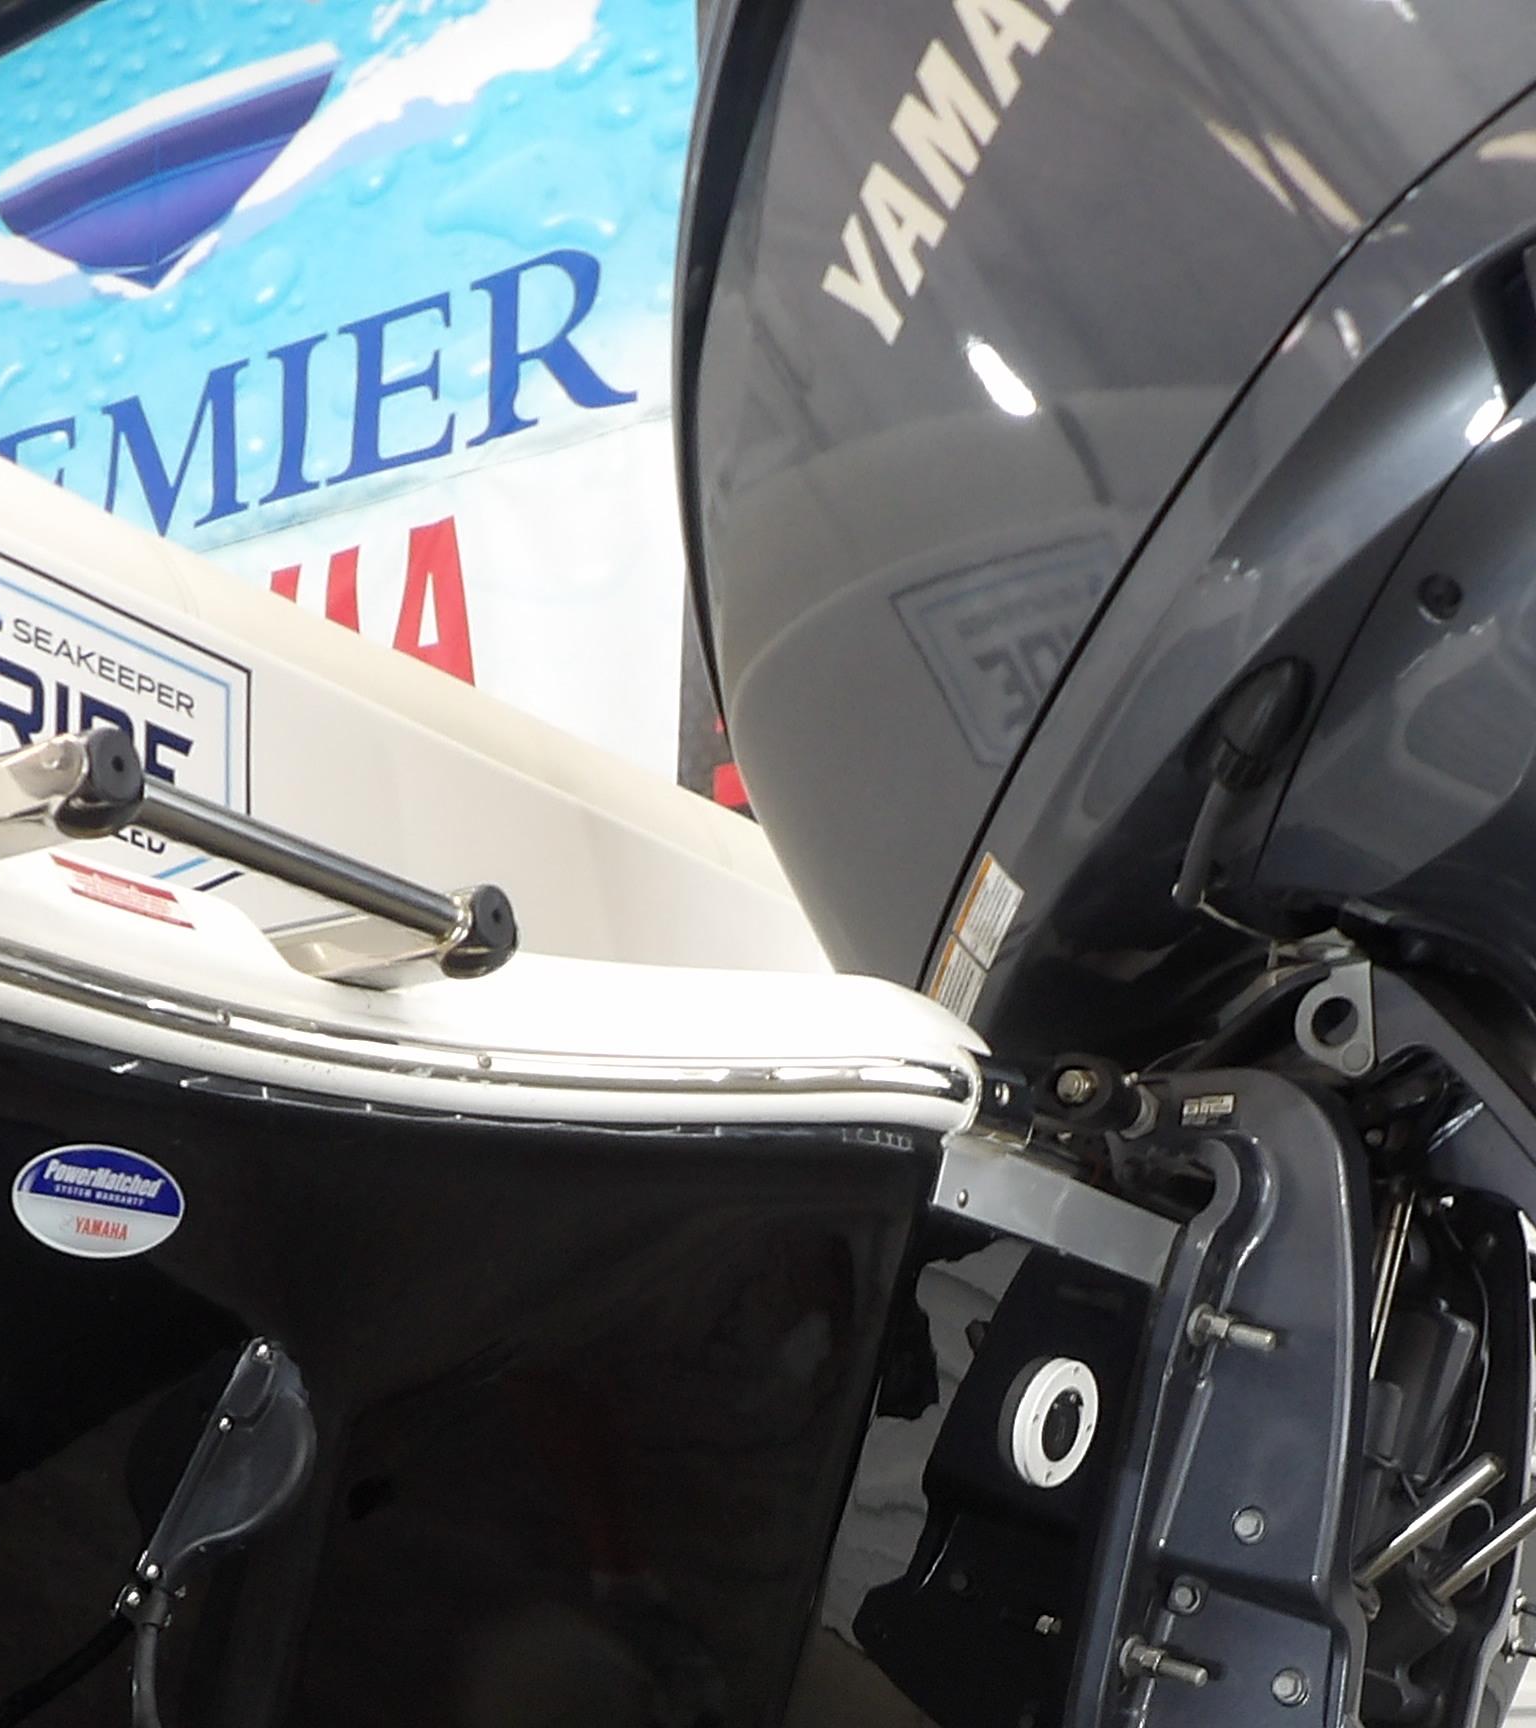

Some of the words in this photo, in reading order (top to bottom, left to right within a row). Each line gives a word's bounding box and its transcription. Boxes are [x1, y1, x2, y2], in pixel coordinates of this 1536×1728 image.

[821, 0, 1069, 346] YAMA
[12, 617, 196, 719] SEAKEEPER
[43, 1158, 164, 1199] PowerMatched
[54, 1184, 92, 1199] SYSTEM
[76, 1217, 129, 1241] YAMAHA
